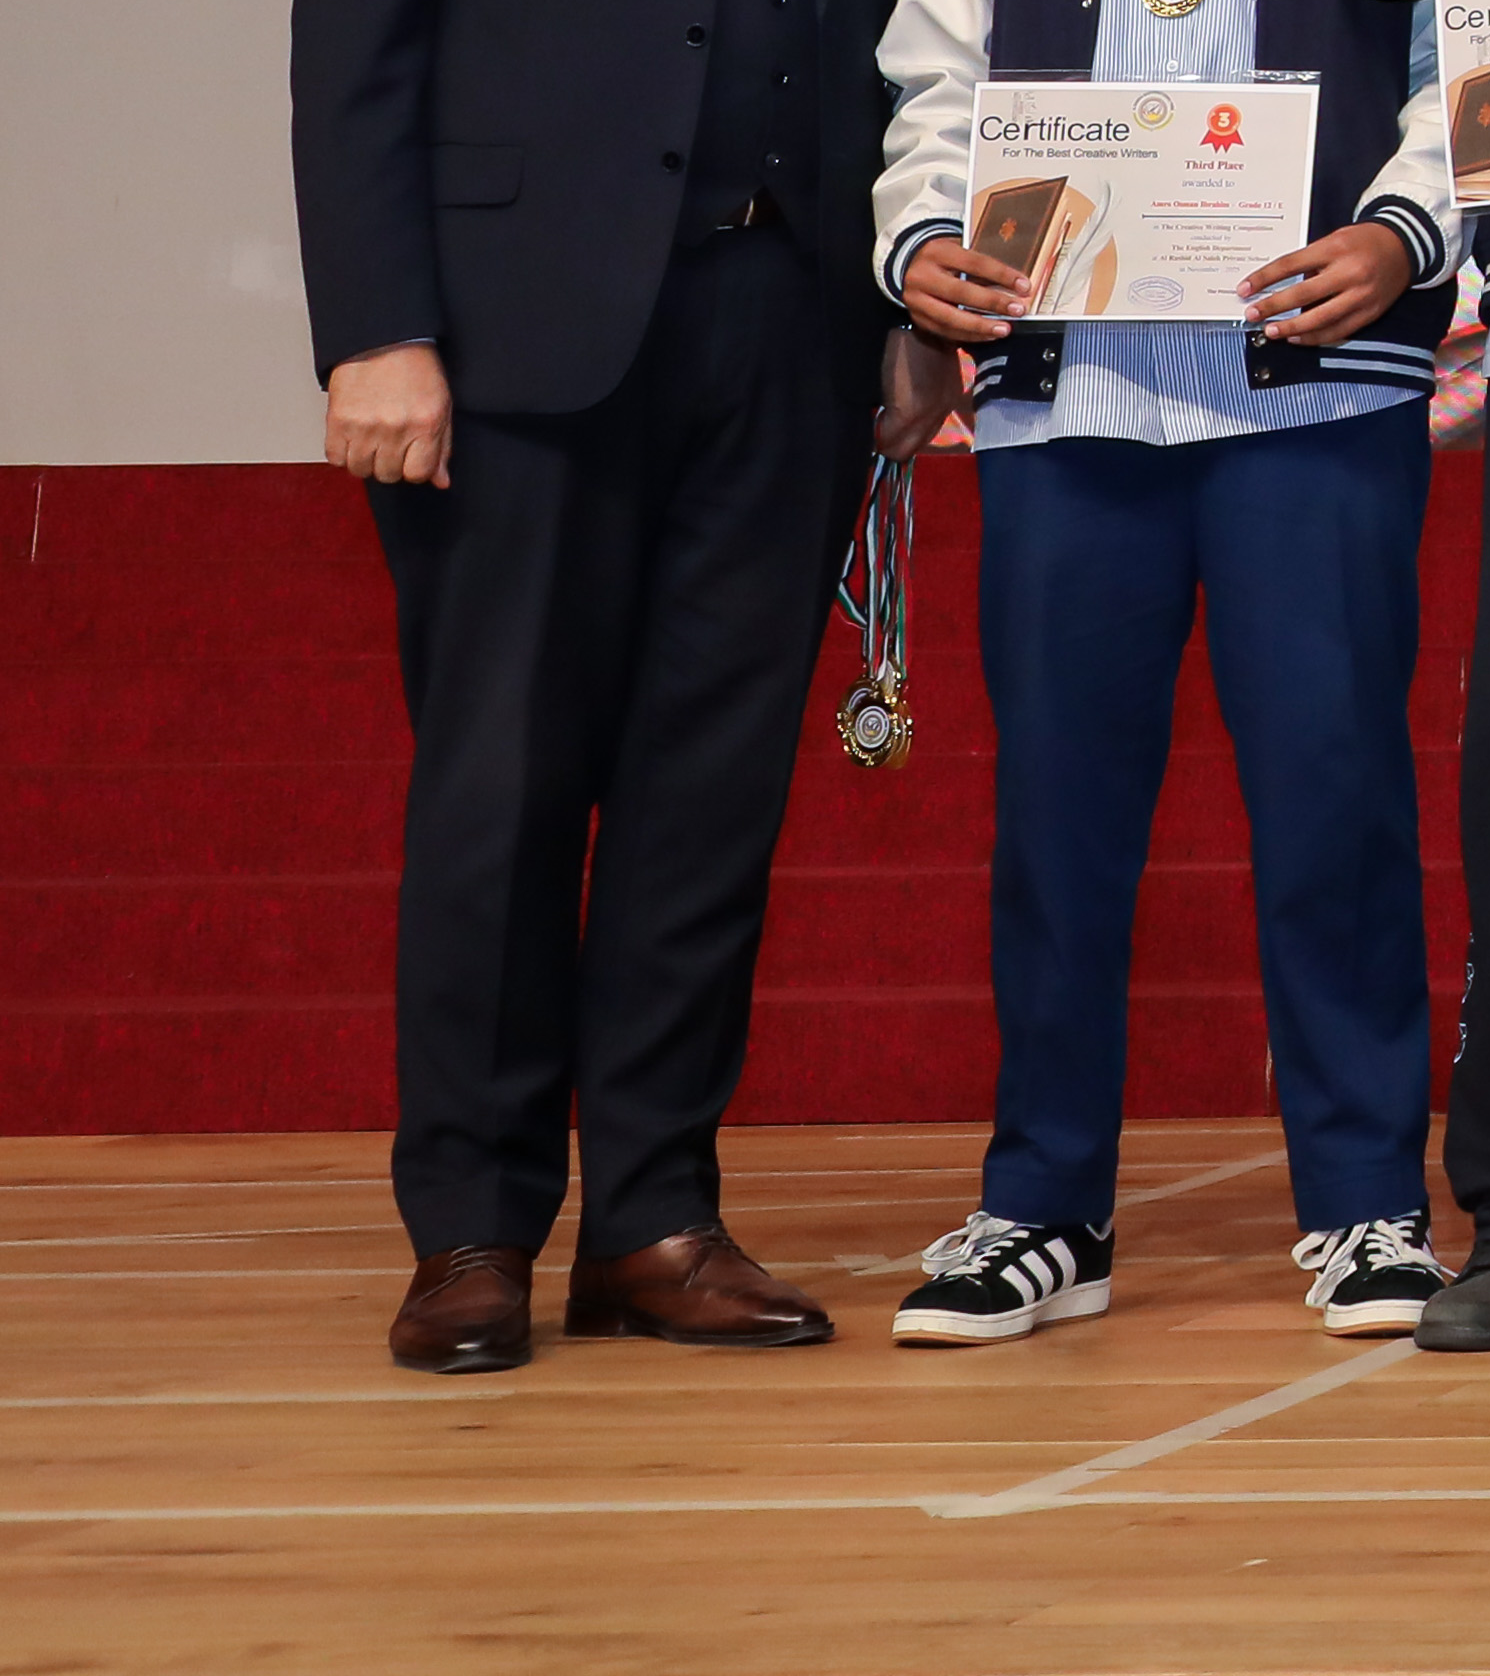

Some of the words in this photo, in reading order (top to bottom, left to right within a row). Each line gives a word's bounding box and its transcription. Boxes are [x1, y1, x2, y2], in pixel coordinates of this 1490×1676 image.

[1470, 33, 1490, 45] For
[1218, 113, 1231, 127] 3
[980, 115, 1131, 142] Certificate
[1003, 148, 1021, 158] For
[1023, 148, 1044, 158] The
[1046, 148, 1070, 158] Best
[1073, 149, 1117, 159] Creative
[1121, 149, 1159, 159] Writers
[1185, 160, 1214, 170] Third
[1218, 161, 1244, 170] Place
[1182, 178, 1223, 188] awarded
[1225, 179, 1235, 188] to
